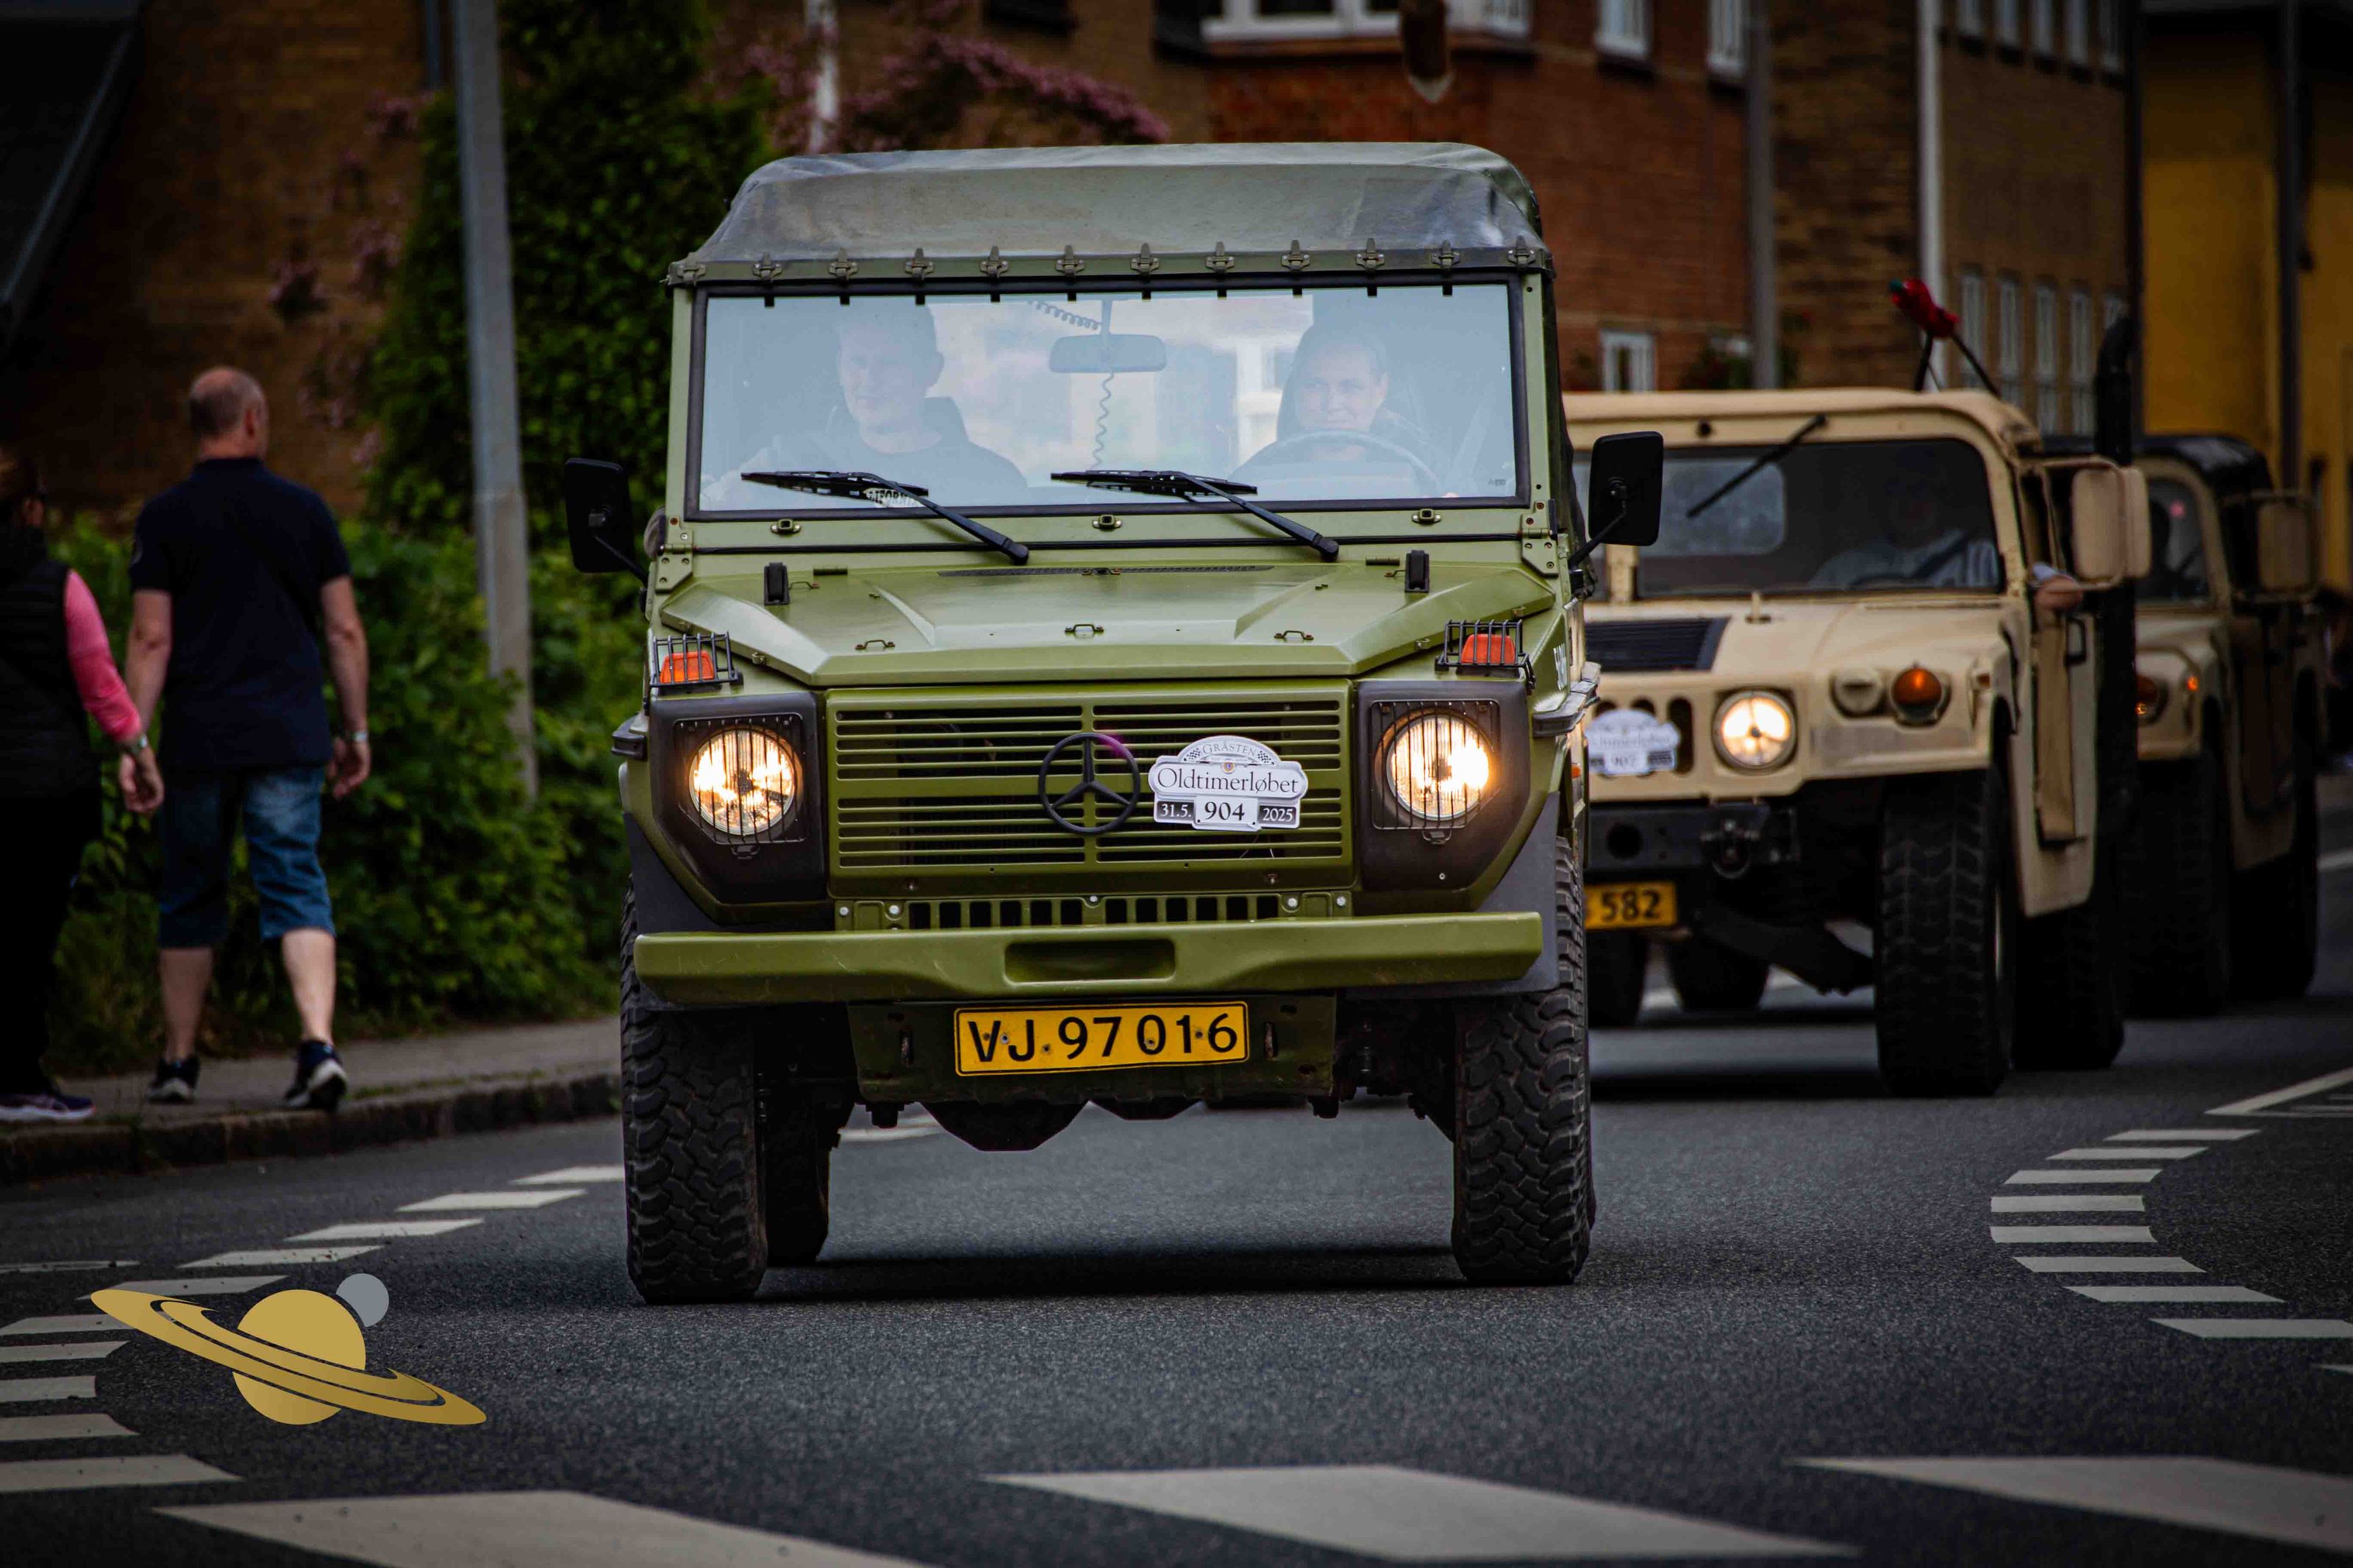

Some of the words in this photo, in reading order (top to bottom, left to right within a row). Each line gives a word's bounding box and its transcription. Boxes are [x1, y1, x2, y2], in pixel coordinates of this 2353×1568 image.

[1202, 742, 1256, 757] GRÅSTEN
[1157, 767, 1299, 794] Oldtimerløbet
[1160, 804, 1191, 818] 31.5.
[1205, 802, 1244, 821] 904
[1263, 808, 1293, 822] 2025
[1601, 889, 1660, 920] 582
[968, 1019, 1035, 1062] VJ
